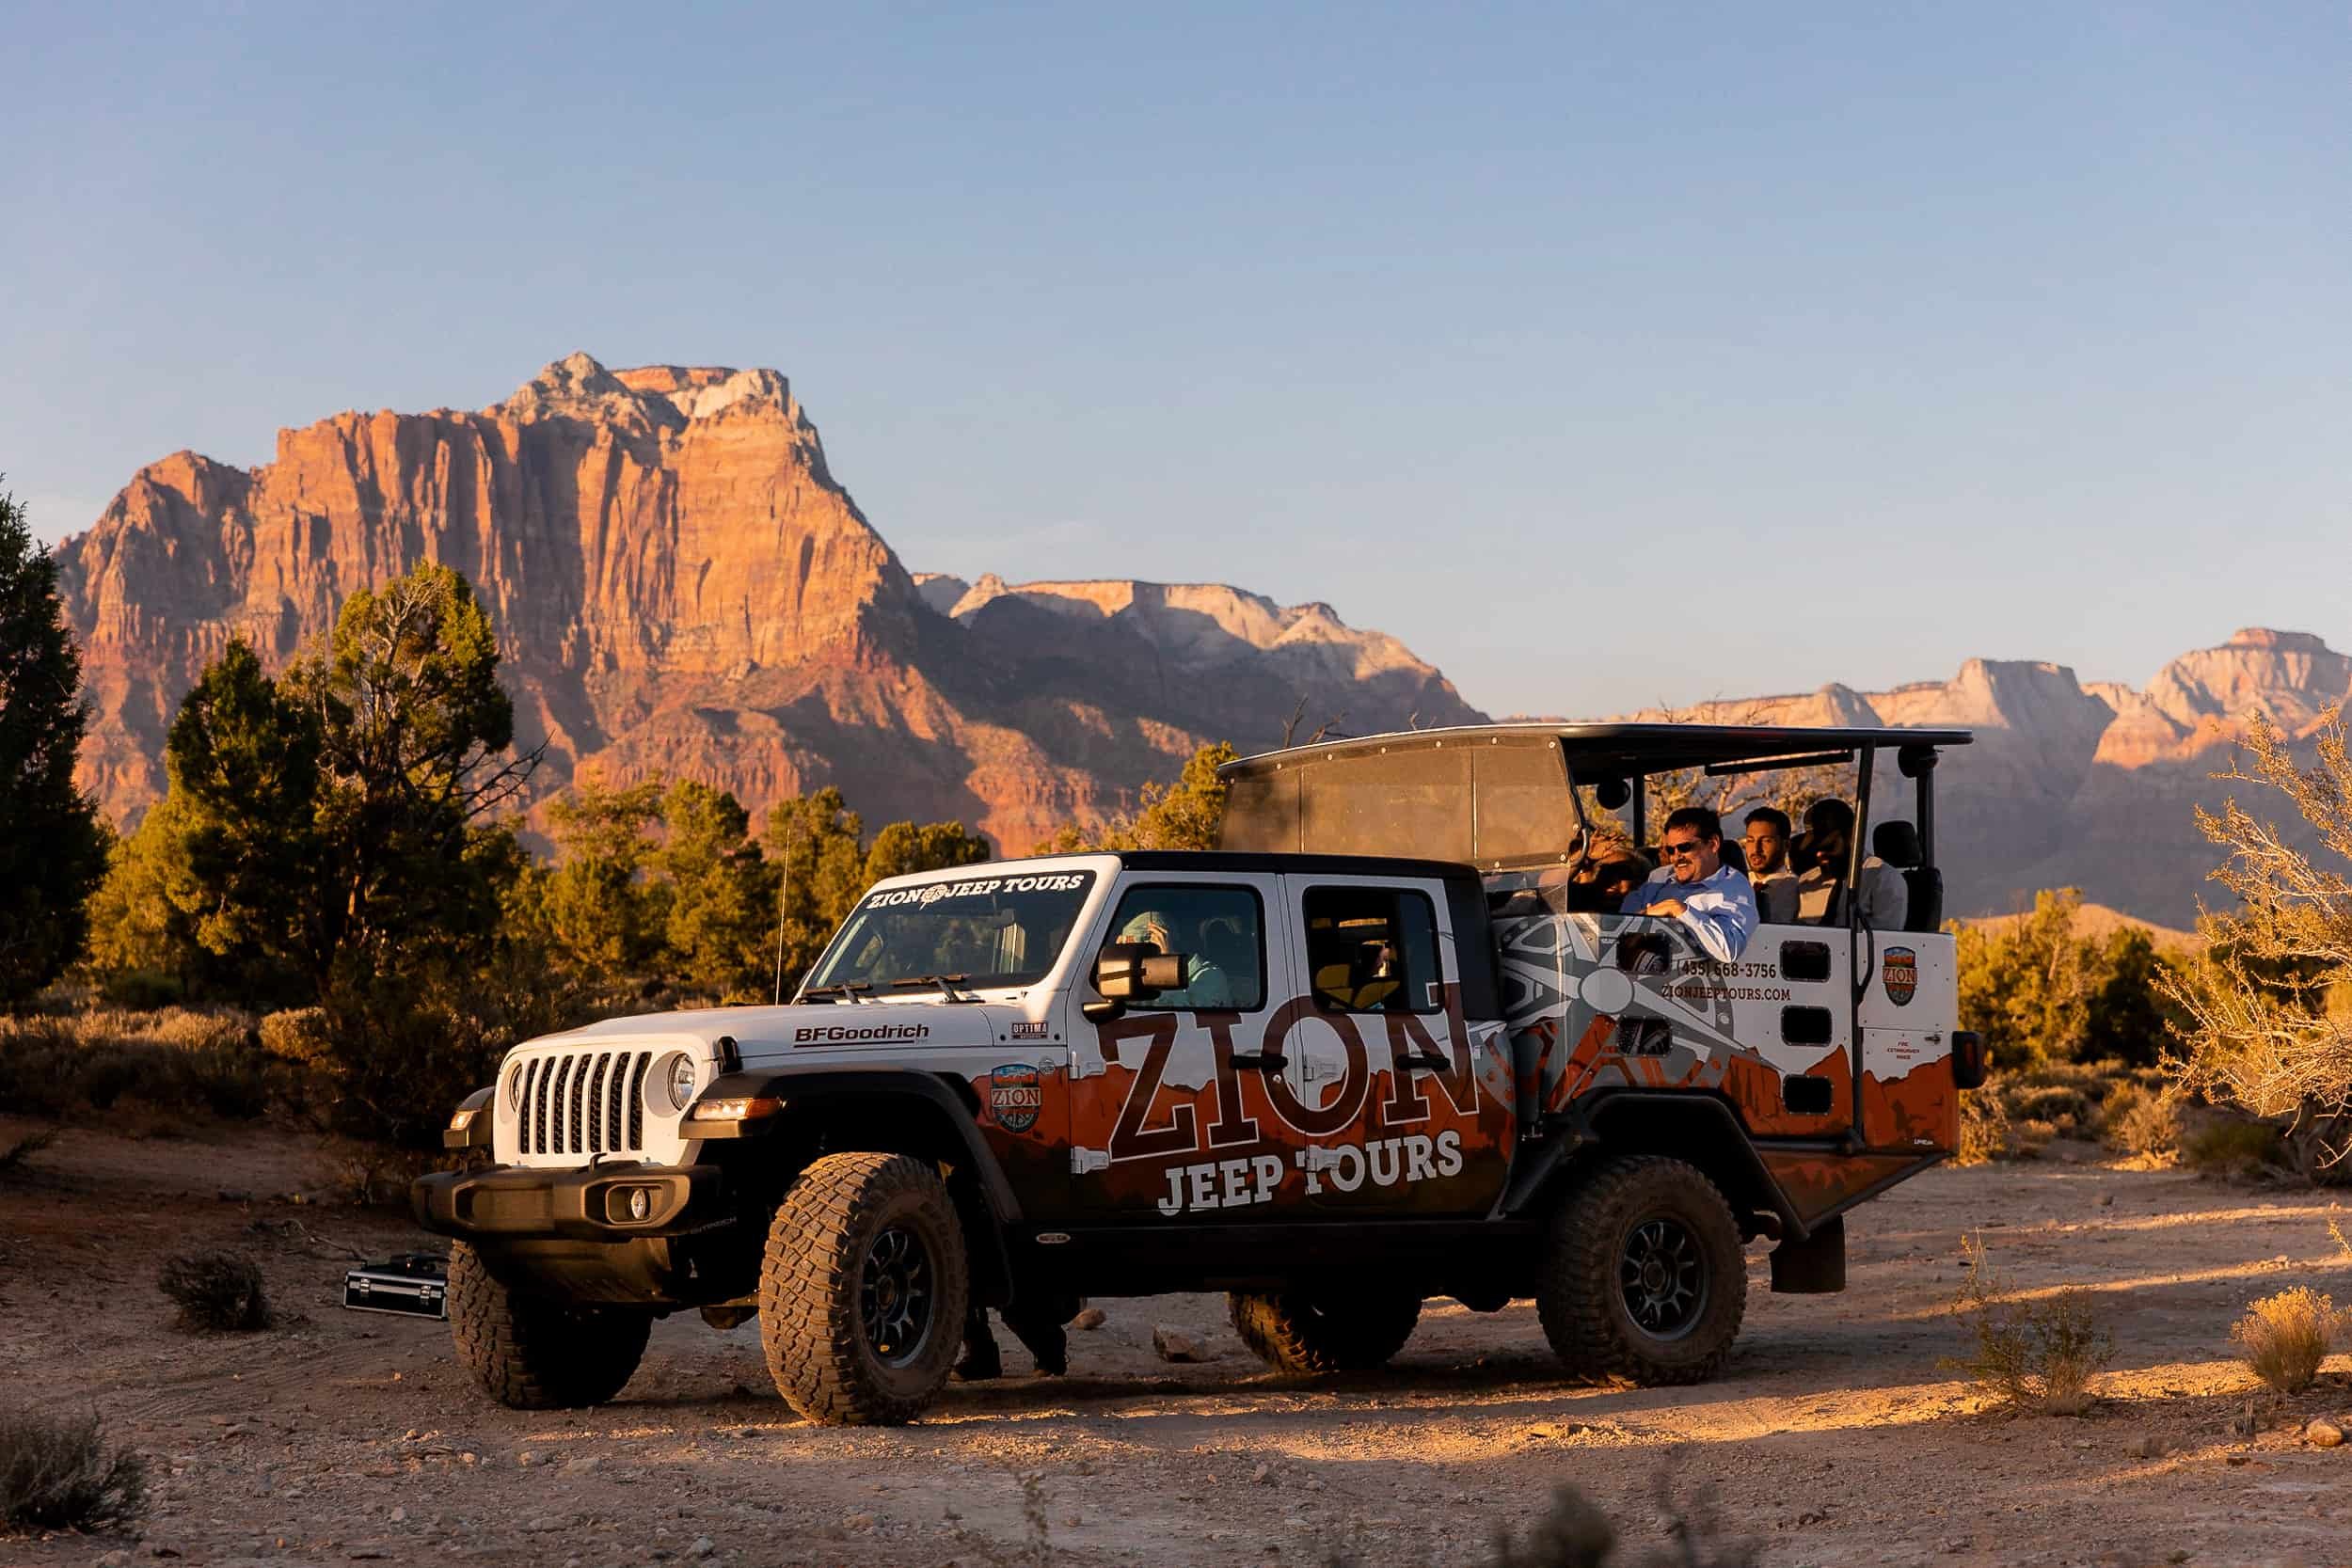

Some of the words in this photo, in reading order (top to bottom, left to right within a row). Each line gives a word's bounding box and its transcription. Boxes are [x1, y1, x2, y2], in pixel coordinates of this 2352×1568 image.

[866, 887, 925, 910] ZION
[945, 879, 1001, 898] JEEP
[1004, 875, 1085, 893] TOURS
[1883, 968, 1916, 984] ZION
[1661, 985, 1791, 1001] ZIONJEEPTOURS.COM
[795, 1022, 930, 1042] BFGoodrich
[1013, 1022, 1047, 1033] OPTIMA
[1096, 979, 1480, 1163] ZION
[993, 1089, 1040, 1106] ZION
[1157, 1153, 1284, 1217] JEEP
[1295, 1130, 1464, 1196] TOURS
